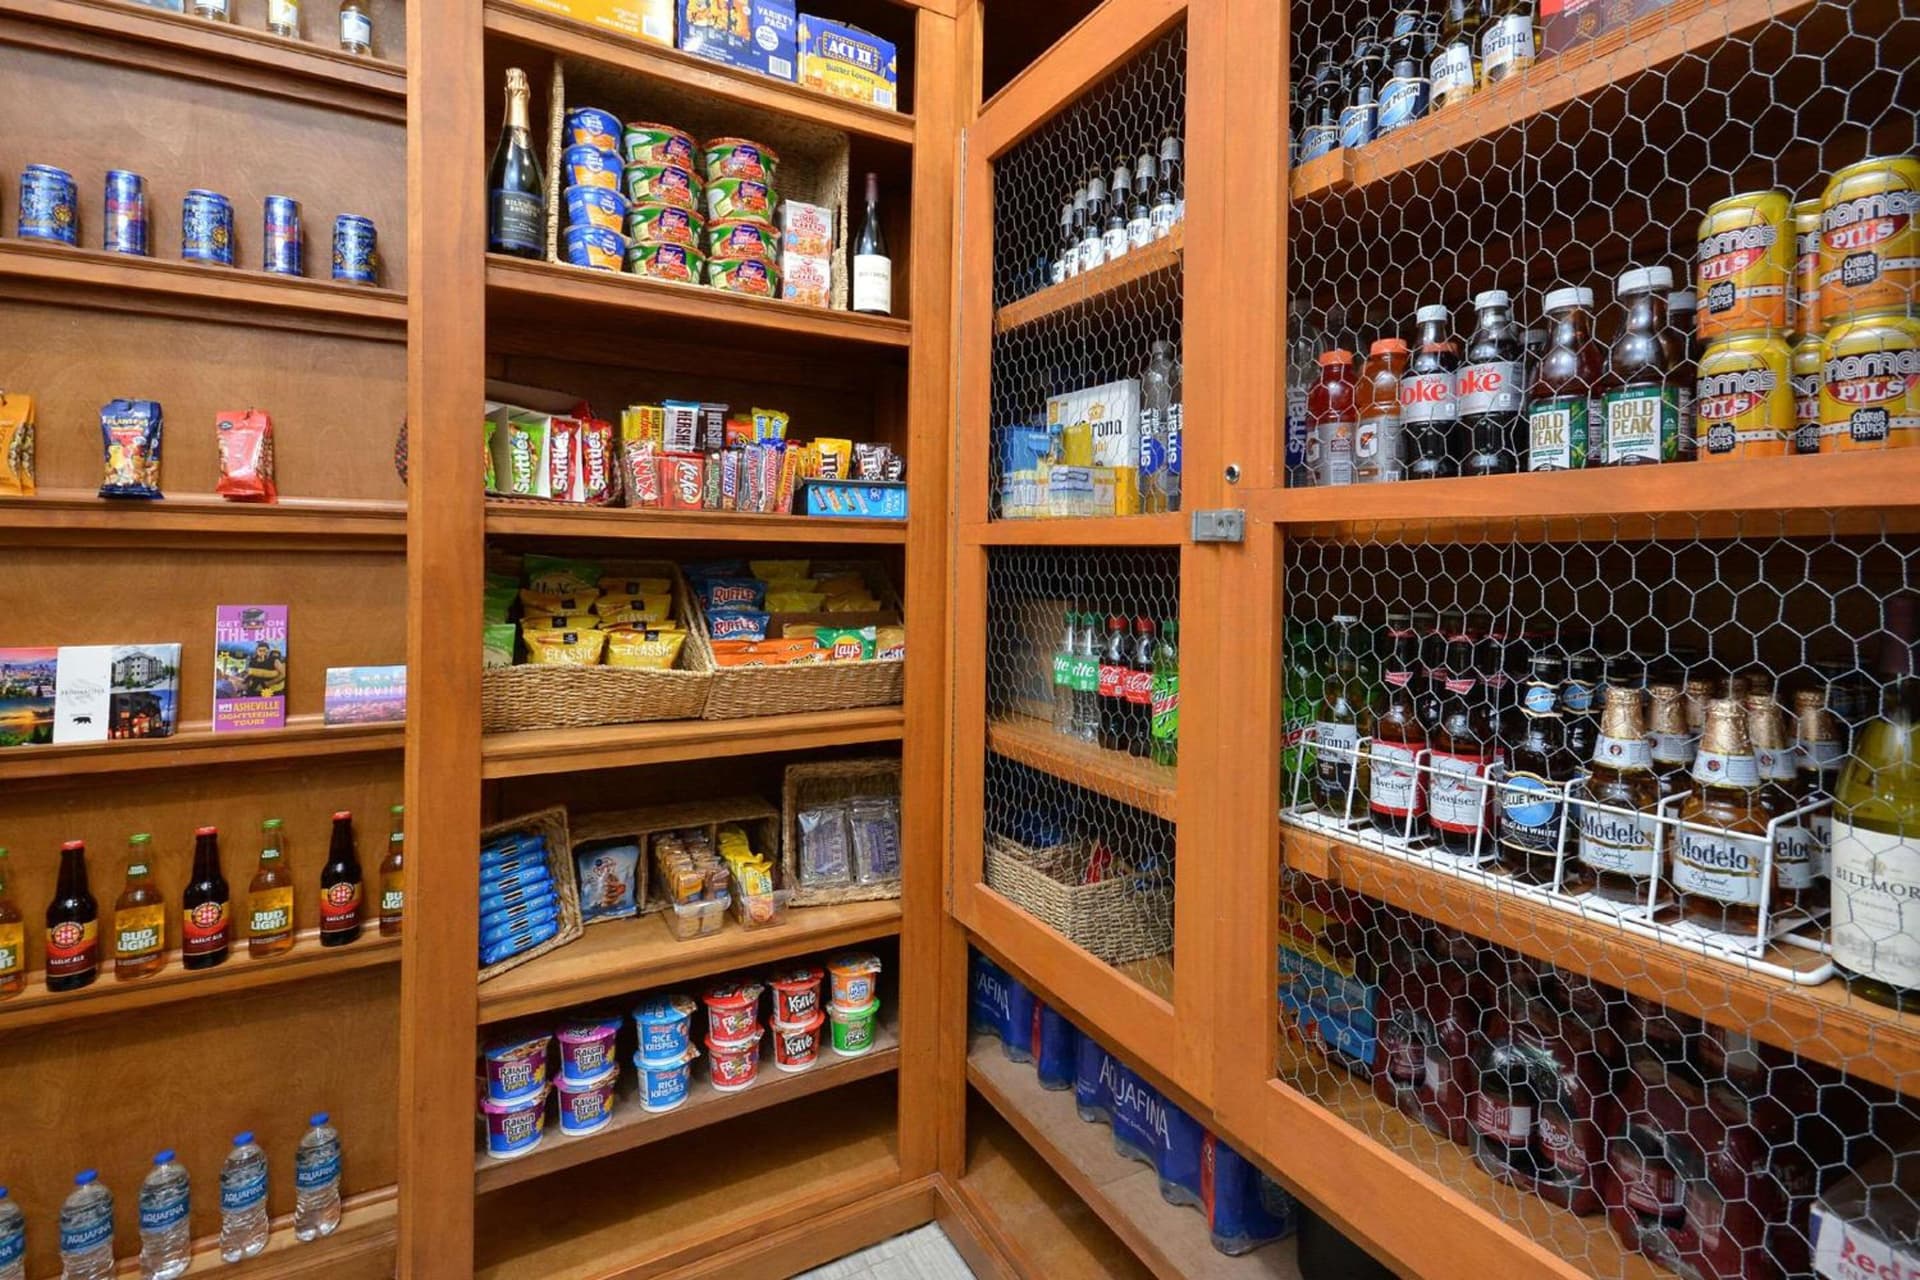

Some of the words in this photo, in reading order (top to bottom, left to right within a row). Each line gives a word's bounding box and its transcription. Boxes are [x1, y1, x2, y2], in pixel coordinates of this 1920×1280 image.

[757, 6, 793, 26] VARIETY
[765, 17, 788, 32] PACK
[828, 39, 855, 58] ACT
[1832, 221, 1895, 249] PILS
[1701, 252, 1750, 279] PILS
[1400, 379, 1449, 406] oke
[1839, 379, 1906, 402] PILS
[1613, 400, 1654, 420] GOLD
[1701, 398, 1751, 419] PILS
[1532, 412, 1564, 430] GOLD
[1613, 417, 1654, 437] PEAK
[1141, 407, 1152, 467] smart
[1168, 403, 1178, 465] smart
[1356, 423, 1378, 459] G
[1532, 428, 1564, 448] PEAK
[513, 430, 529, 494] Skittles
[551, 431, 569, 492] Skittles
[589, 431, 605, 491] Skittles
[218, 620, 239, 628] GET
[713, 618, 760, 636] RUFFLES
[218, 627, 250, 642] THE
[254, 627, 286, 642] BUS
[545, 648, 594, 661] CLASSIC
[623, 644, 673, 657] CLASSIC
[834, 642, 863, 659] Lay's
[233, 701, 281, 712] ASHEVILLE
[218, 711, 281, 721] SIGHTSEEING
[234, 718, 266, 727] TOURS
[1529, 825, 1559, 840] WHITE
[1584, 813, 1646, 846] Modelo
[1835, 864, 1920, 900] BILTMOR
[382, 899, 404, 910] LIG
[385, 890, 403, 902] BU
[250, 915, 289, 931] LIGHT
[253, 909, 285, 922] BUD
[121, 928, 153, 942] BUD
[117, 936, 158, 952] LIGHT
[788, 990, 816, 1014] Krave
[977, 972, 1010, 1021] AFINA
[645, 1040, 680, 1052] KRISPIES
[651, 1034, 672, 1043] RICE
[784, 1033, 814, 1055] Krave
[574, 1045, 604, 1059] Raisin
[579, 1053, 602, 1065] Bran
[500, 1063, 532, 1077] Raisin
[503, 1071, 528, 1083] Bran
[650, 1084, 685, 1099] KRISPIES
[658, 1078, 678, 1090] RICE
[573, 1093, 603, 1108] Raisin
[576, 1102, 601, 1115] Bran
[1099, 1054, 1172, 1150] AQUAFINA
[503, 1112, 536, 1128] Raisin
[507, 1121, 532, 1134] Bran
[299, 1165, 338, 1184] AQUAFINA
[224, 1184, 266, 1204] AQUAFINA
[143, 1204, 185, 1224] AQUAFINA
[66, 1222, 112, 1246] AQUAFINA
